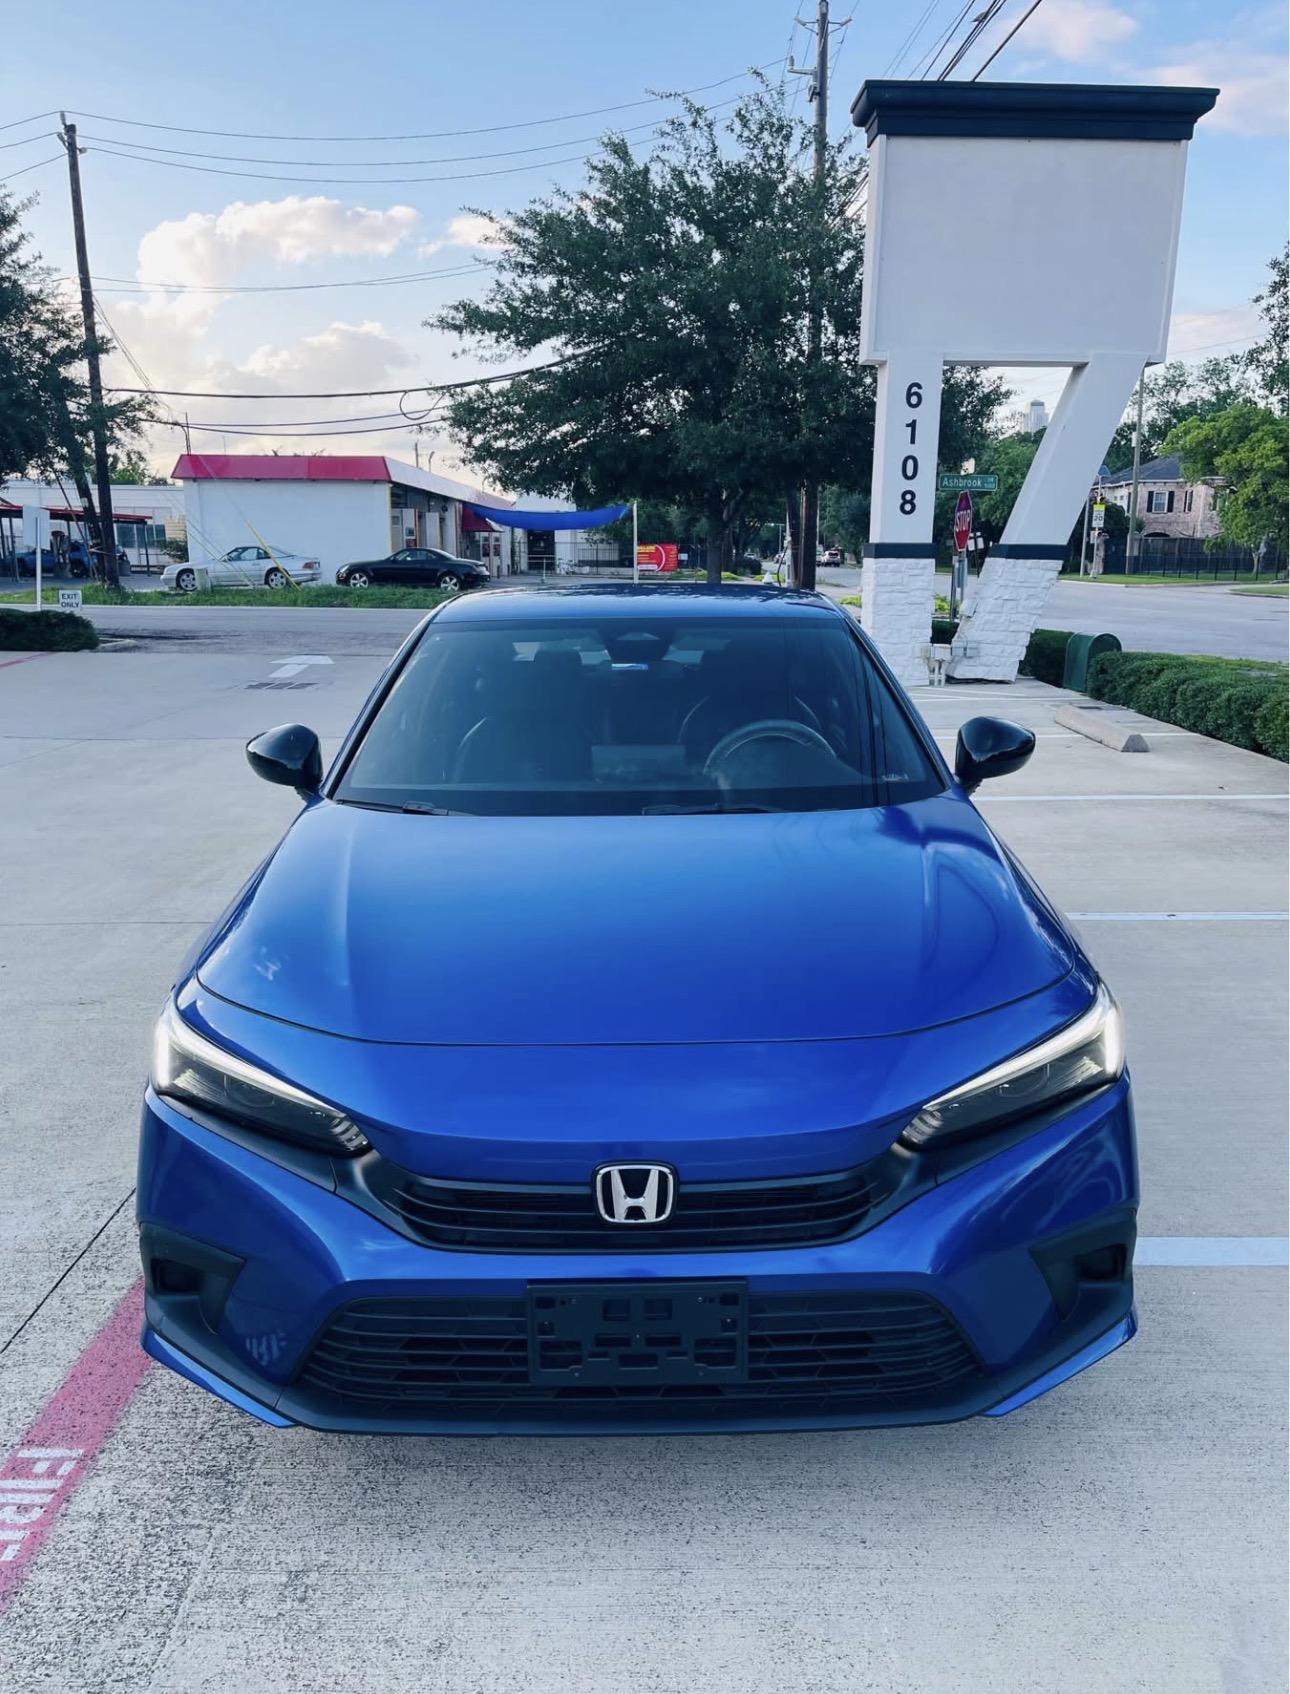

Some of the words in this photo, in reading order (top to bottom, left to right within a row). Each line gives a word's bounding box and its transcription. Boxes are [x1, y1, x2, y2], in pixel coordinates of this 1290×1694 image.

[899, 382, 923, 515] 6108
[942, 477, 982, 487] Ashbrook
[956, 510, 970, 532] STOP
[608, 1166, 661, 1222] H
